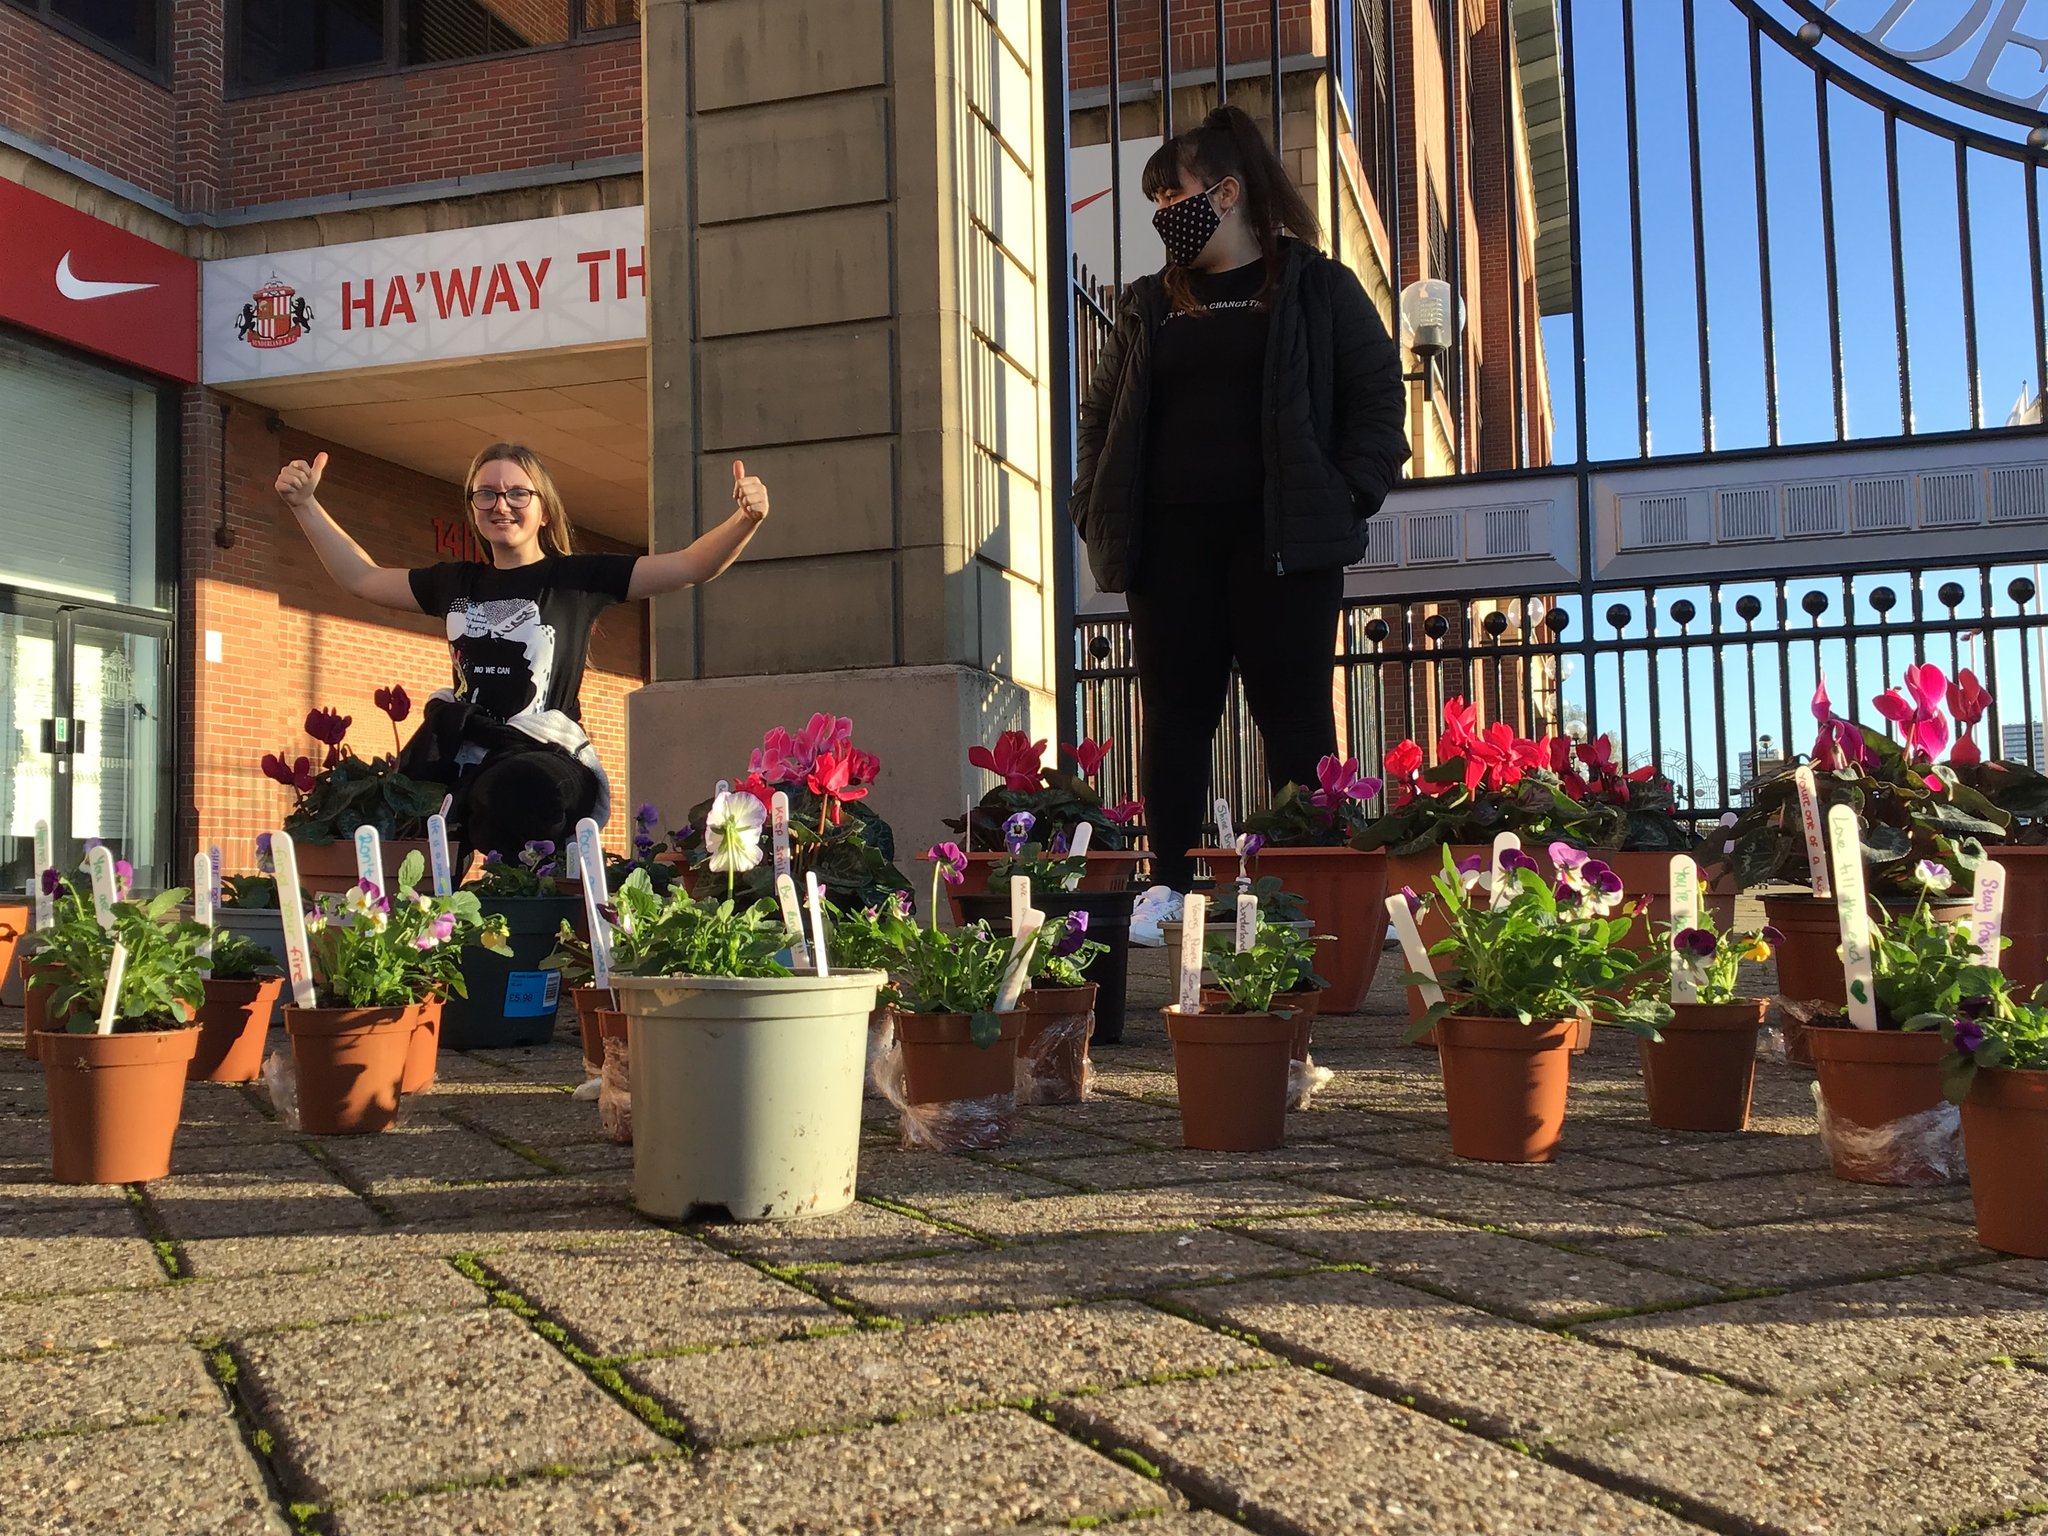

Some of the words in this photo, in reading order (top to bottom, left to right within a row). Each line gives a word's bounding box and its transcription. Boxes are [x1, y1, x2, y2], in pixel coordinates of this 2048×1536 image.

[341, 257, 552, 331] HA'WAY
[1208, 300, 1248, 310] CHANGE
[485, 666, 496, 674] WE
[496, 666, 511, 675] CAN
[1832, 817, 1849, 854] Love
[1842, 896, 1857, 923] the
[1974, 879, 1998, 913] Stay
[1239, 901, 1254, 952] Sunderland
[286, 946, 304, 983] fire
[1846, 930, 1865, 965] end
